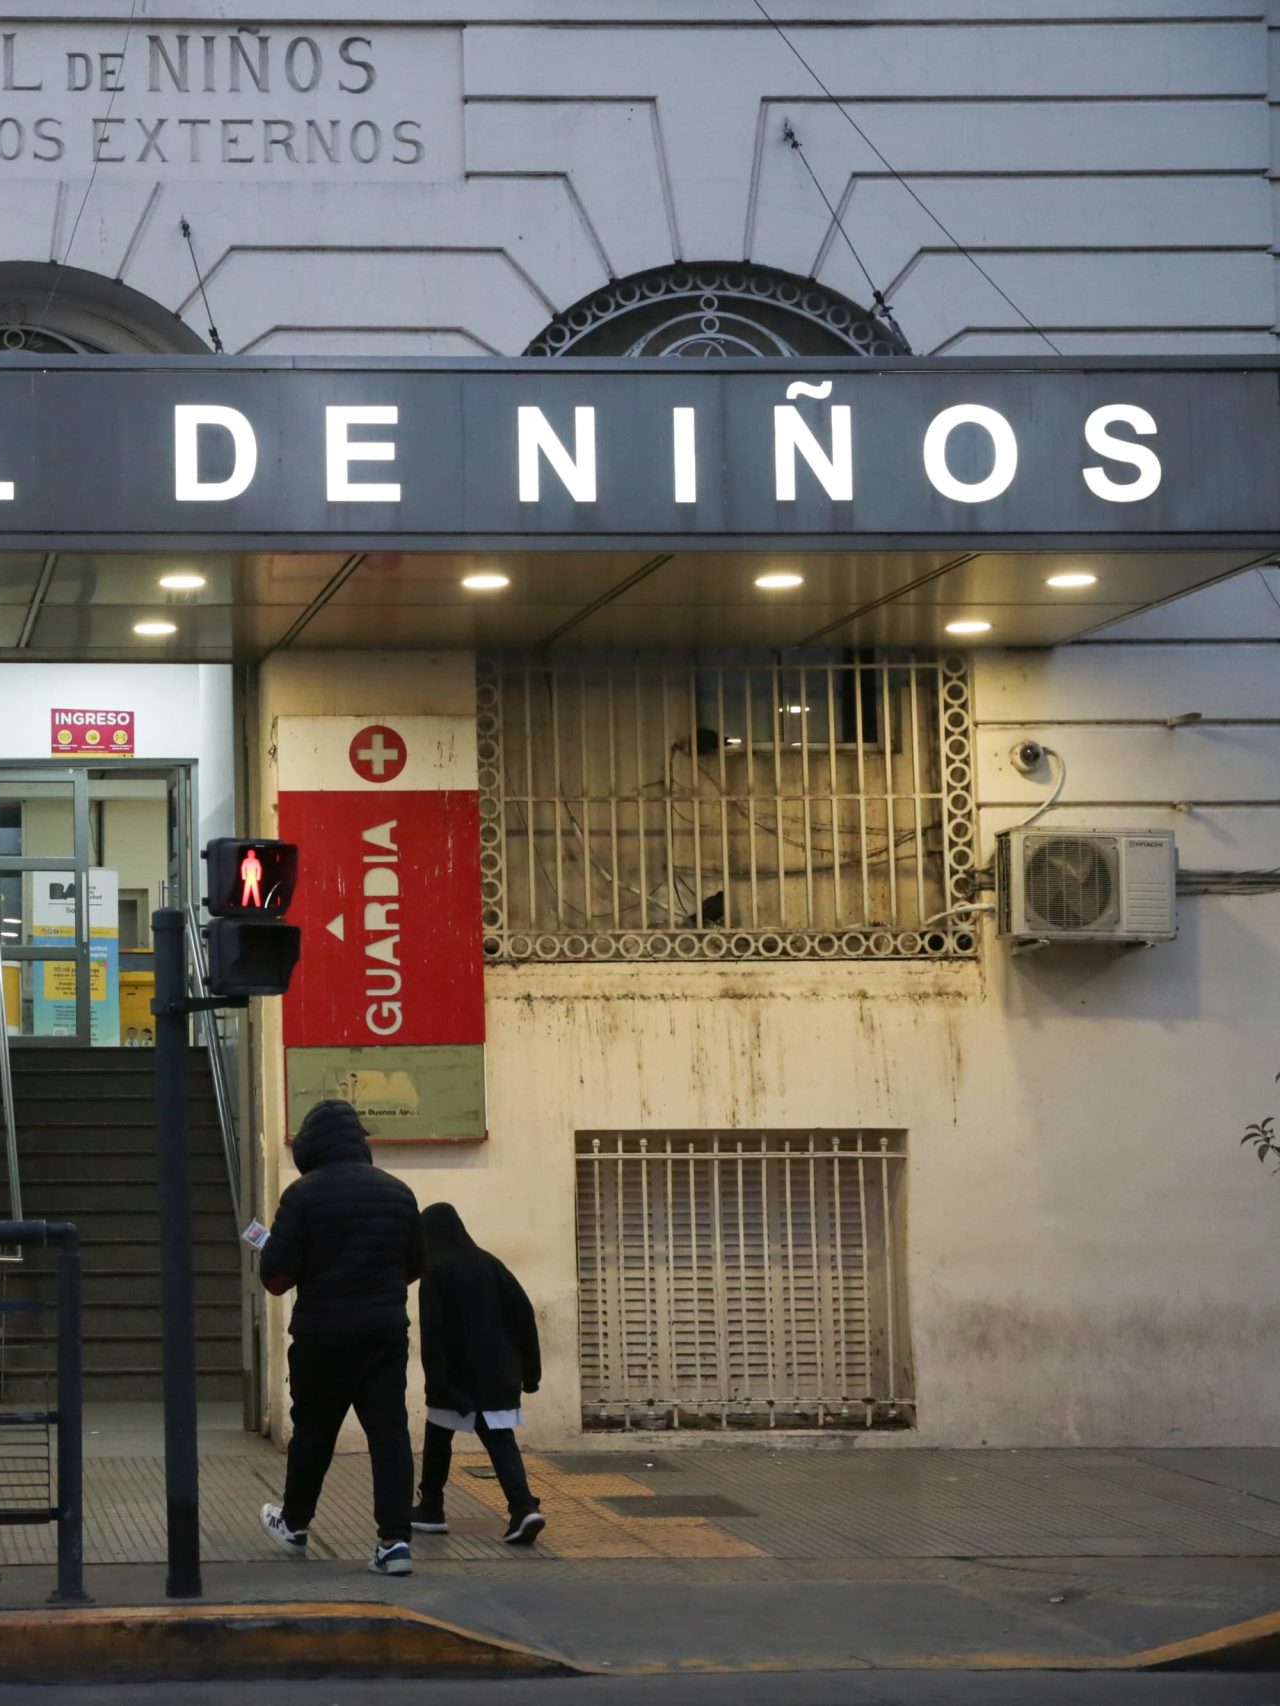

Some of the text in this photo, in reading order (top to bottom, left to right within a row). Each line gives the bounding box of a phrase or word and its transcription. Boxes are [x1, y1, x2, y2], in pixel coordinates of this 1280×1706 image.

[67, 51, 124, 93] DE
[146, 26, 377, 94] NIÑOS
[92, 116, 424, 165] EXTERNOS
[175, 405, 402, 503] DE
[518, 380, 1163, 504] NIÑOS
[55, 712, 130, 726] INGRESO
[361, 819, 403, 1035] GUARDIA
